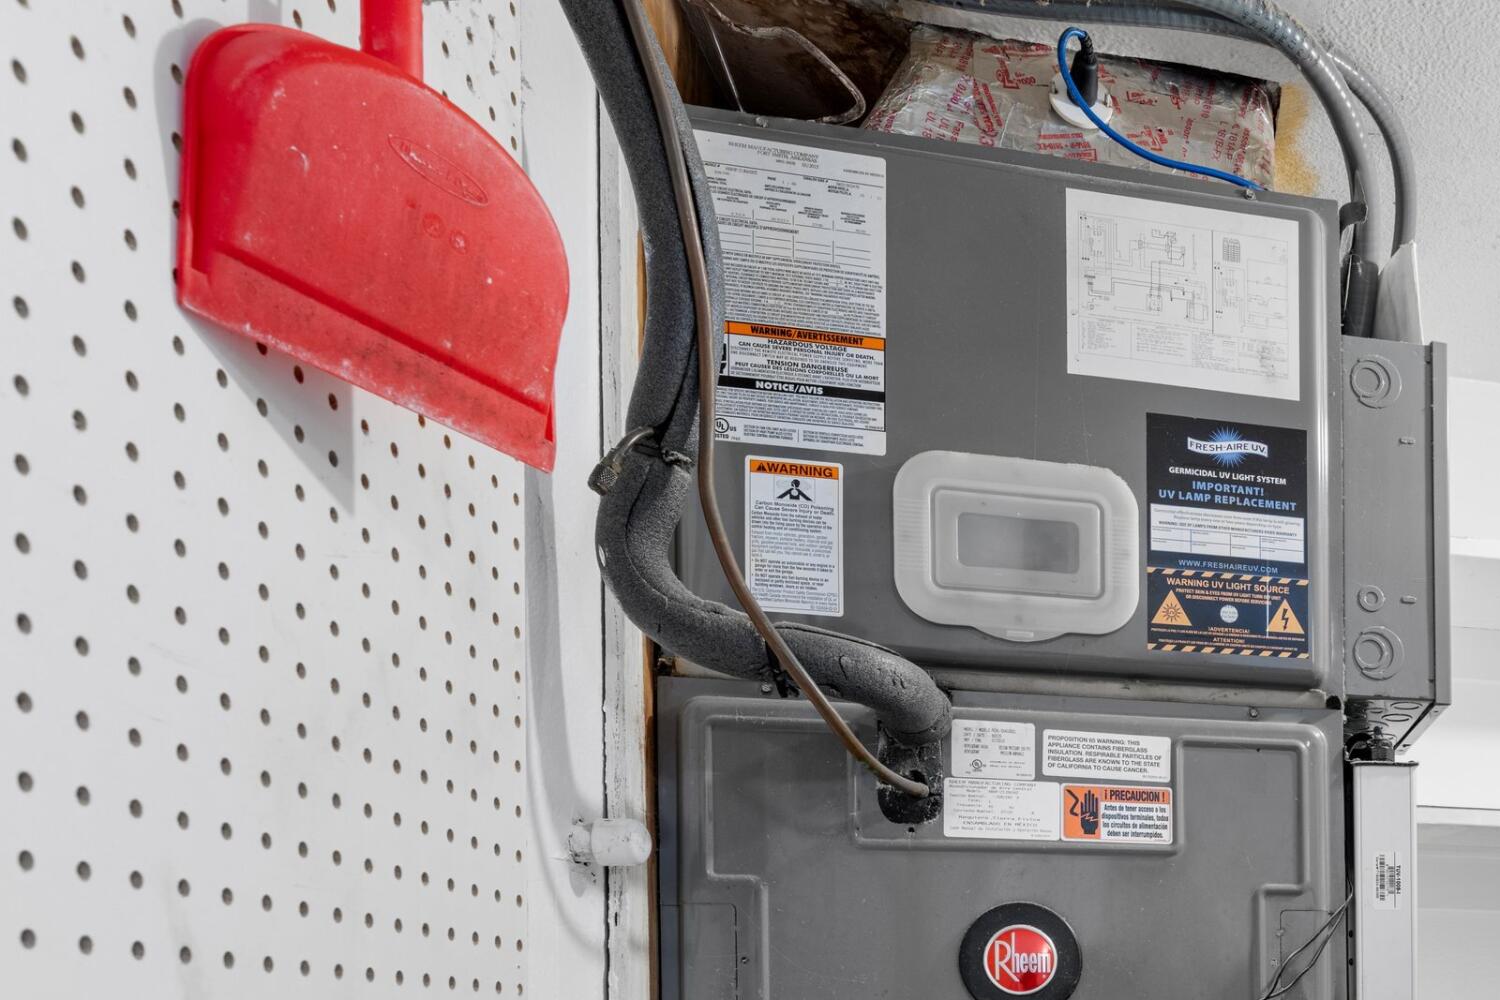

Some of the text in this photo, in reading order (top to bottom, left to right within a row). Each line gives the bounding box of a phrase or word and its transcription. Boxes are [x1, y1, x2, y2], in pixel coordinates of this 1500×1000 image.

[751, 326, 864, 345] WARNING/AVERTISSEMENT
[768, 339, 847, 352] HAZARDOUS VOLTAGE
[767, 360, 848, 372] TENSION DANGEREUSE
[808, 369, 844, 377] CORPORELLES
[755, 381, 824, 395] NOTICE/AVIS
[1190, 441, 1248, 451] FRESH-AIRE
[767, 462, 833, 478] WARNING
[1169, 466, 1217, 478] GERMICIDAL
[1232, 472, 1255, 482] LIGHT
[1256, 475, 1286, 485] SYSTEM
[1192, 481, 1264, 496] IMPORTANT!
[1159, 489, 1296, 511] UV LAMP REPLACEMENT
[1178, 559, 1278, 574] WWW.FRESHAIREUV.COM
[1167, 577, 1209, 588] WARNING
[1226, 582, 1251, 590] LIGHT
[1254, 584, 1290, 594] SOURCE
[1048, 735, 1088, 743] PROPOSITION
[1110, 790, 1160, 802] PRECAUCION
[994, 932, 1051, 982] Rheem
